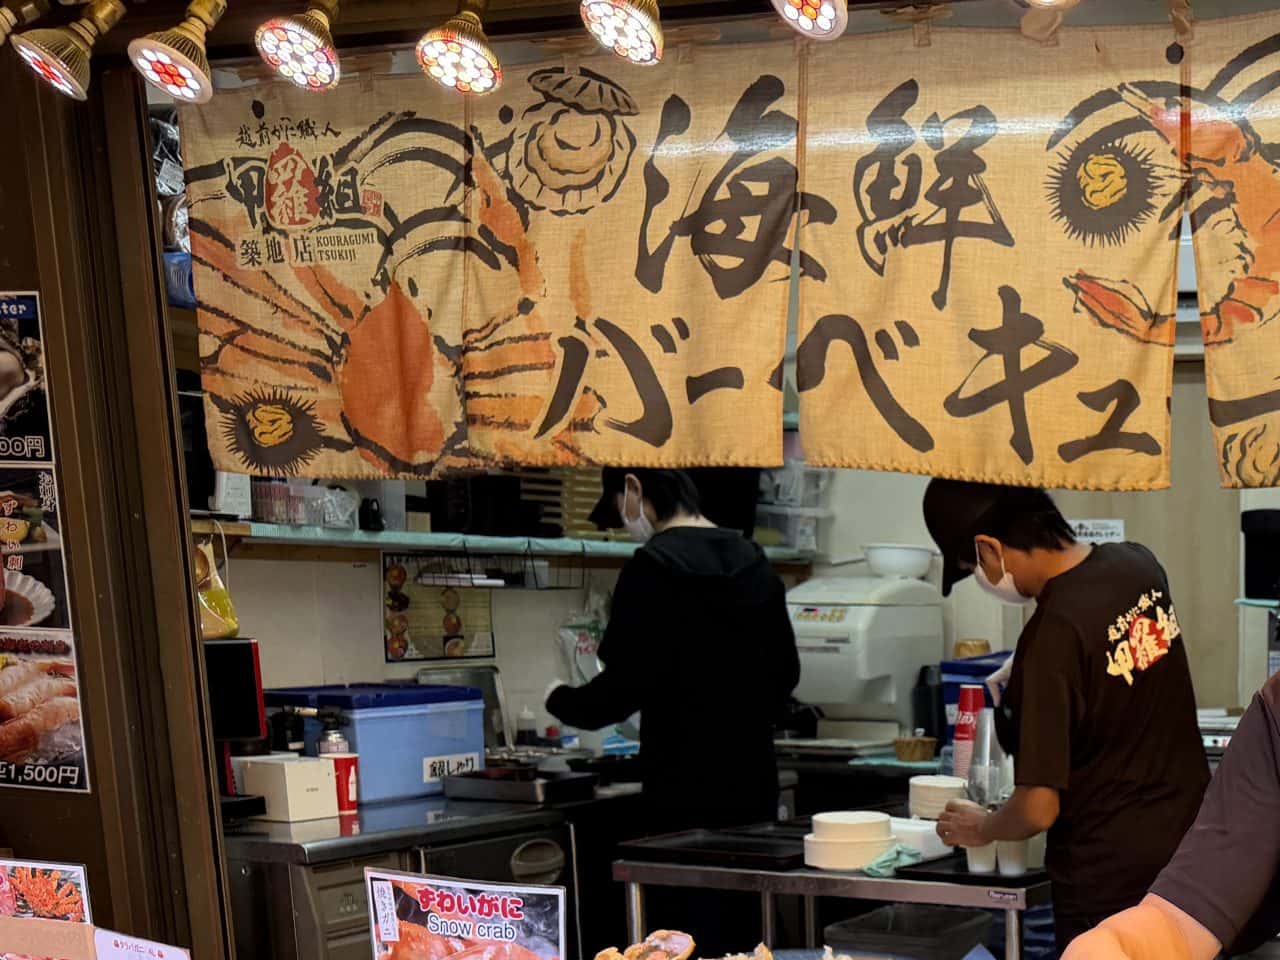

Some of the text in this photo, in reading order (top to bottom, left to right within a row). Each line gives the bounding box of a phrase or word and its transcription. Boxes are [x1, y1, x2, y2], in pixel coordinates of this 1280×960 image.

[236, 117, 342, 148] 越前がに職人
[225, 154, 361, 229] 甲羅組
[635, 74, 1016, 311] 海鮮
[240, 235, 314, 267] 築地店
[316, 232, 375, 248] KOURAGUMI
[317, 249, 357, 262] TSUKIJI
[0, 303, 27, 315] ter
[427, 914, 517, 940] Snow crab
